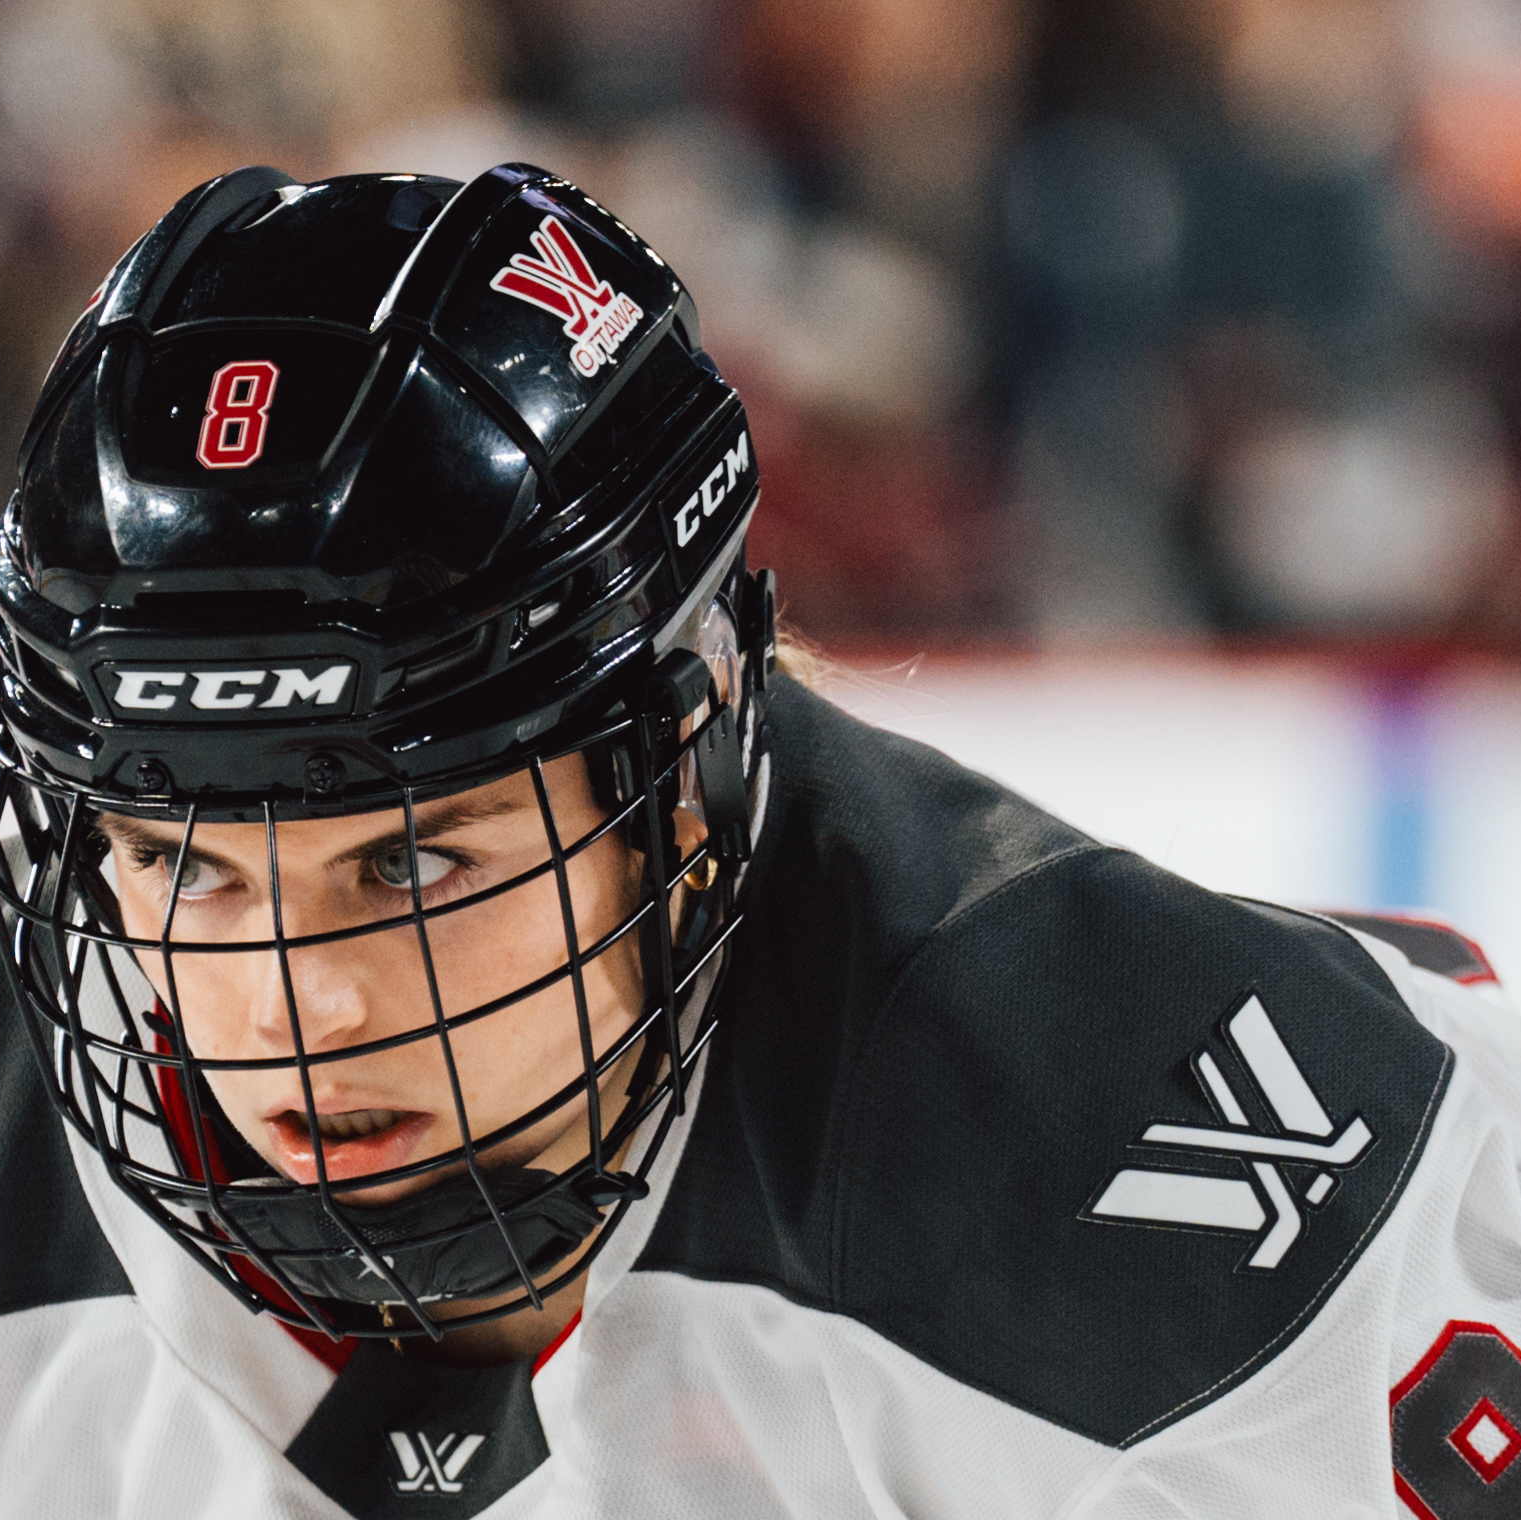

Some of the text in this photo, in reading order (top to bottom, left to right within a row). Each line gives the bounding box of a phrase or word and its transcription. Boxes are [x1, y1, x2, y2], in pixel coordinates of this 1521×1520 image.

[573, 296, 641, 373] OTTAWA
[196, 360, 280, 470] 8
[673, 430, 749, 548] CCM
[114, 665, 352, 709] CCM
